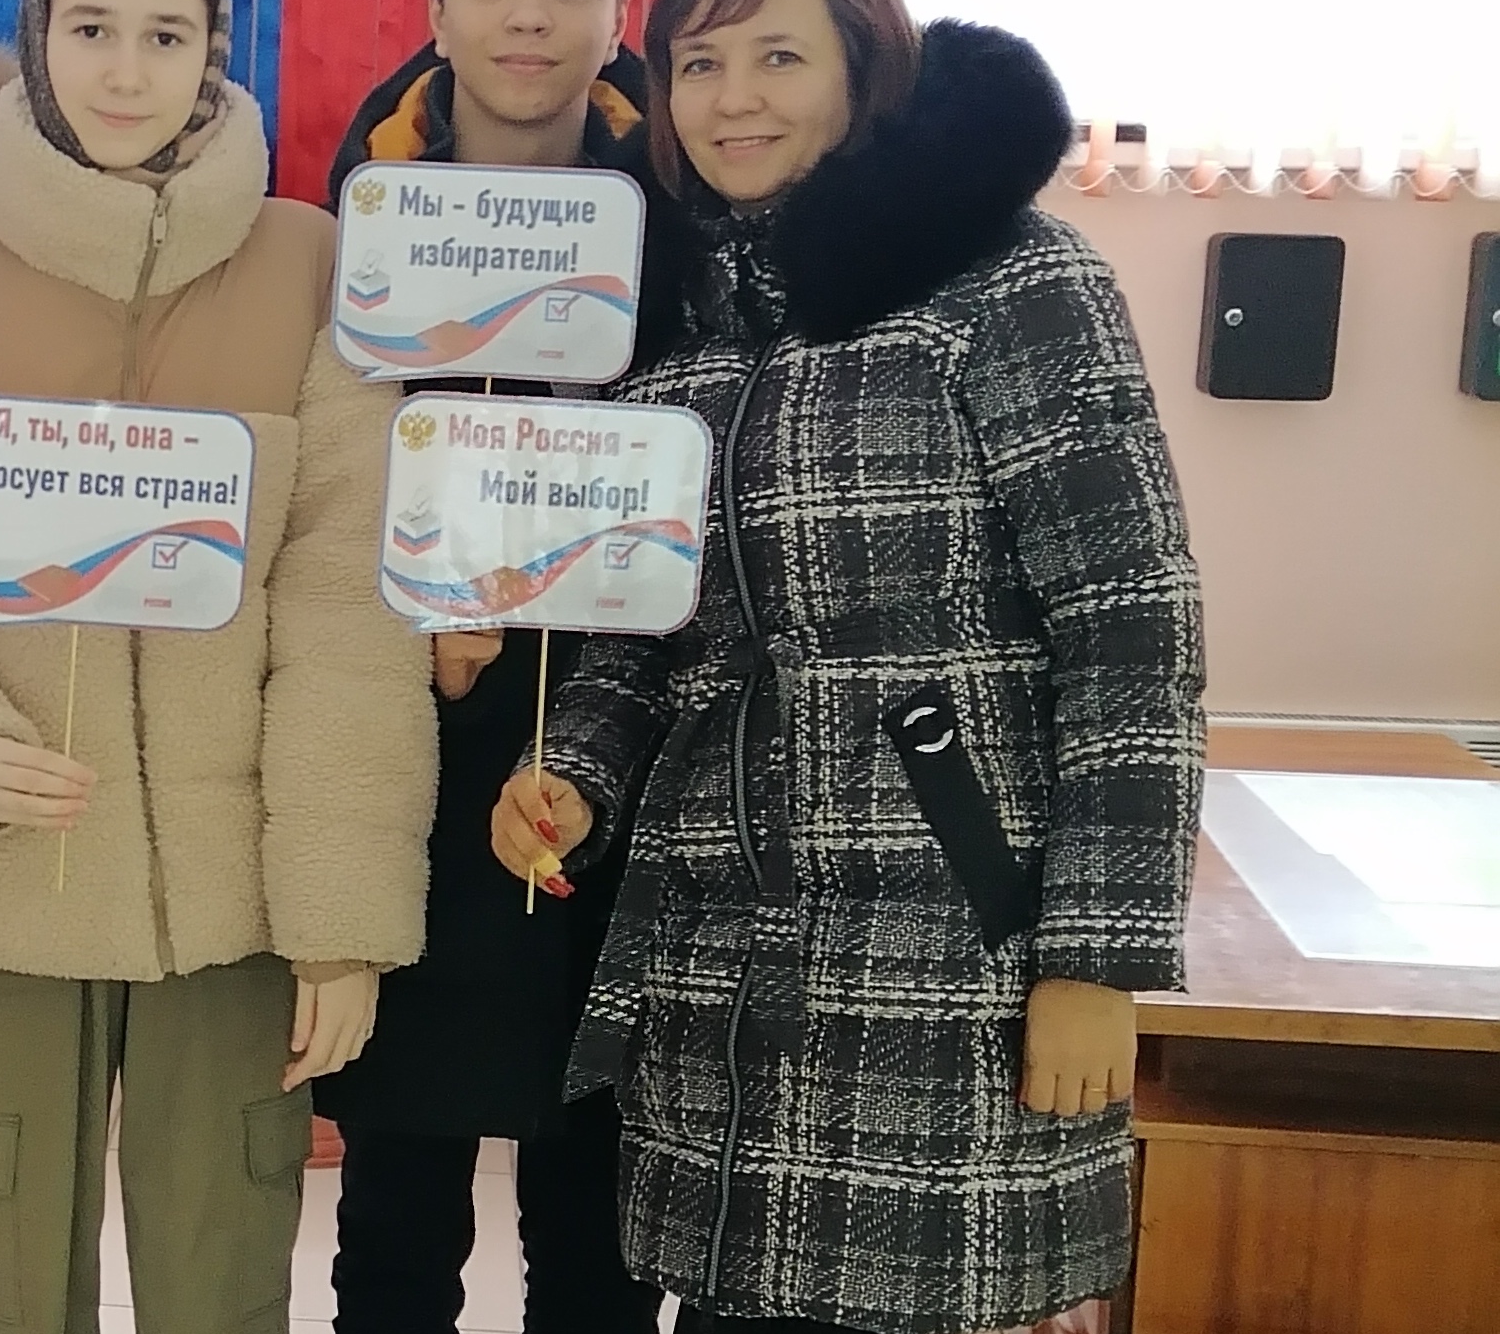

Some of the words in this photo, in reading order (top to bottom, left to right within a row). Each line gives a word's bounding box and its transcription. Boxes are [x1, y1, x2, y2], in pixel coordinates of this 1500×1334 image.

[399, 185, 443, 217] Мы
[476, 190, 596, 227] будущие
[409, 240, 578, 276] избиратели!
[28, 418, 69, 450] ты,
[78, 422, 116, 452] он,
[125, 424, 173, 451] она
[448, 414, 505, 450] Моя
[516, 417, 620, 457] Россия
[79, 472, 124, 498] вся
[134, 474, 239, 508] страна!
[480, 469, 537, 506] Мой
[548, 478, 650, 517] выбор!
